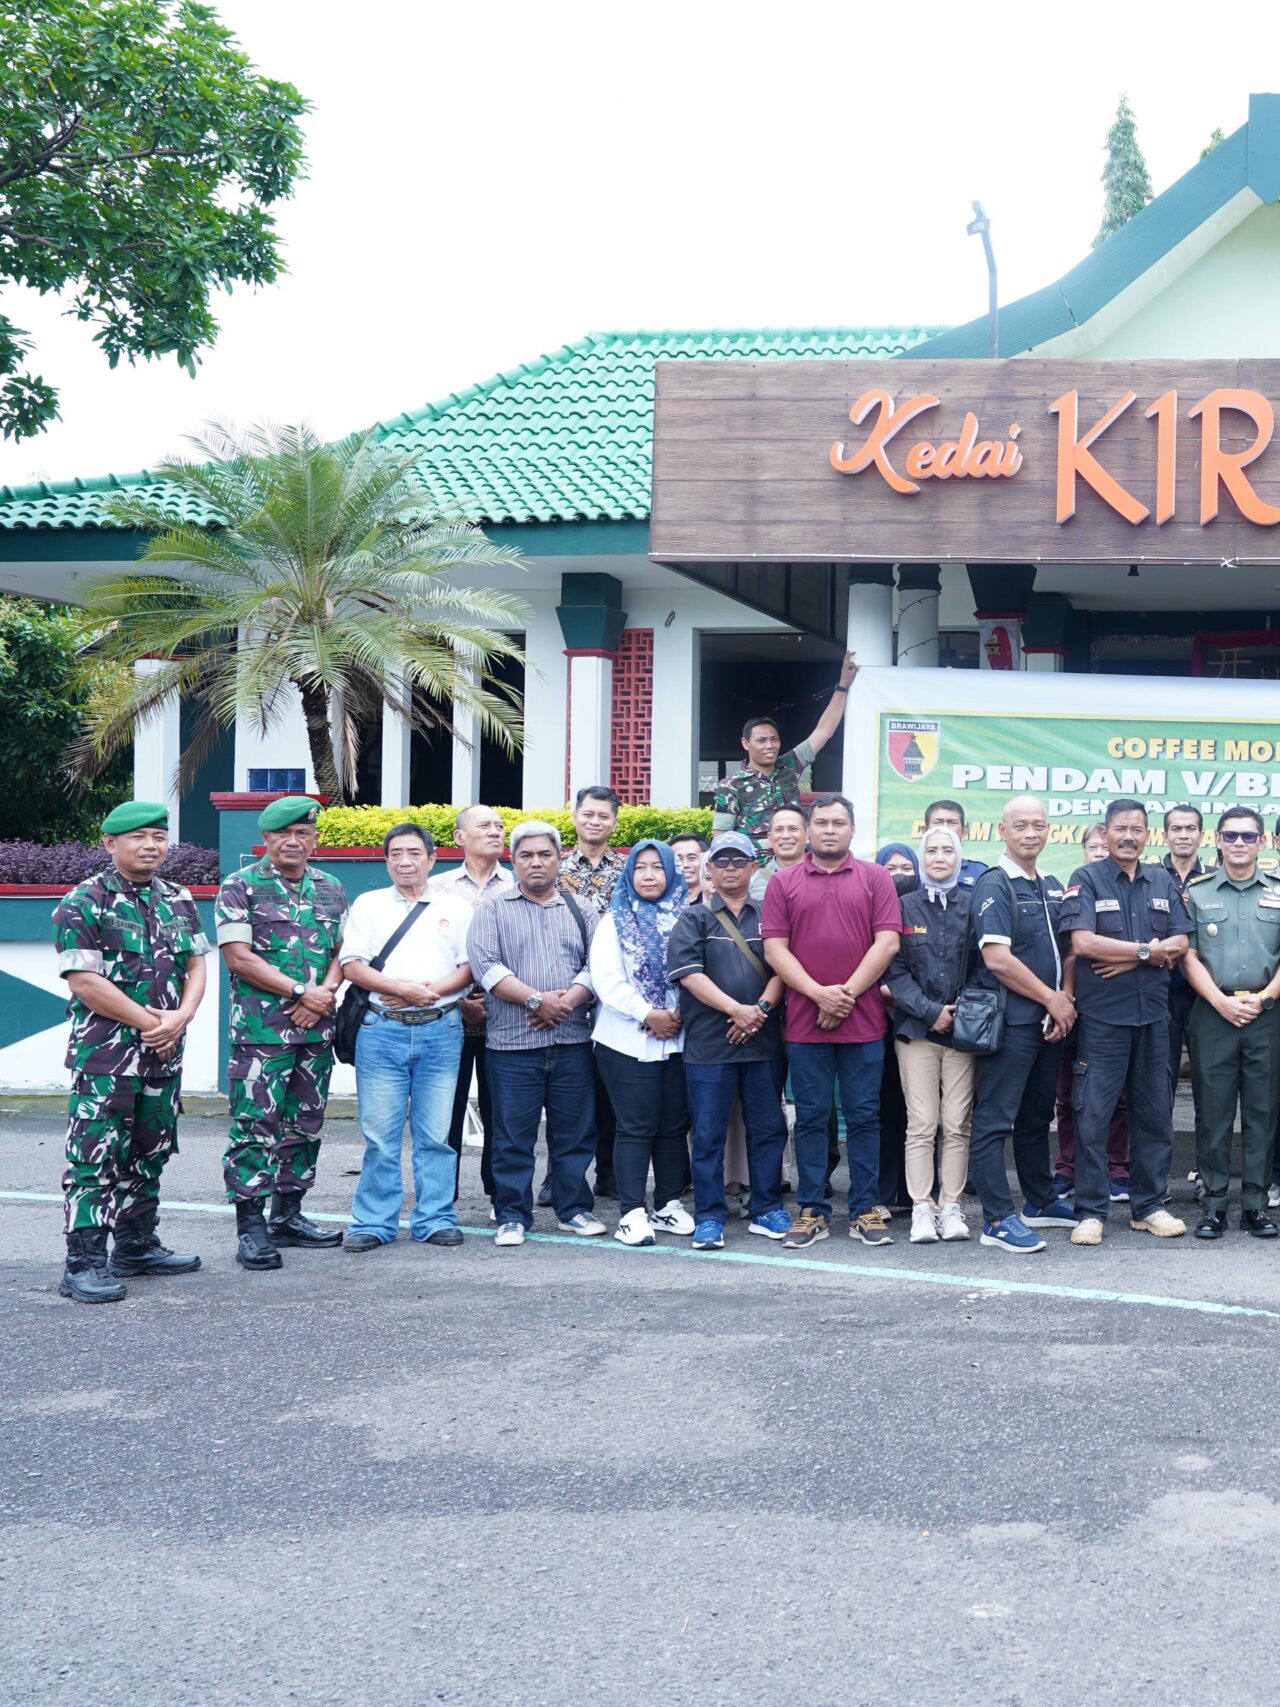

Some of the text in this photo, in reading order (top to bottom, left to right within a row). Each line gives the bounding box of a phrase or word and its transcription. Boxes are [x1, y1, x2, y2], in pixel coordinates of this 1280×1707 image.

[830, 388, 1024, 494] Kedai
[890, 722, 936, 731] BRAWIJAYA
[1107, 736, 1216, 760] COFFEE
[952, 763, 1166, 795] PENDAM
